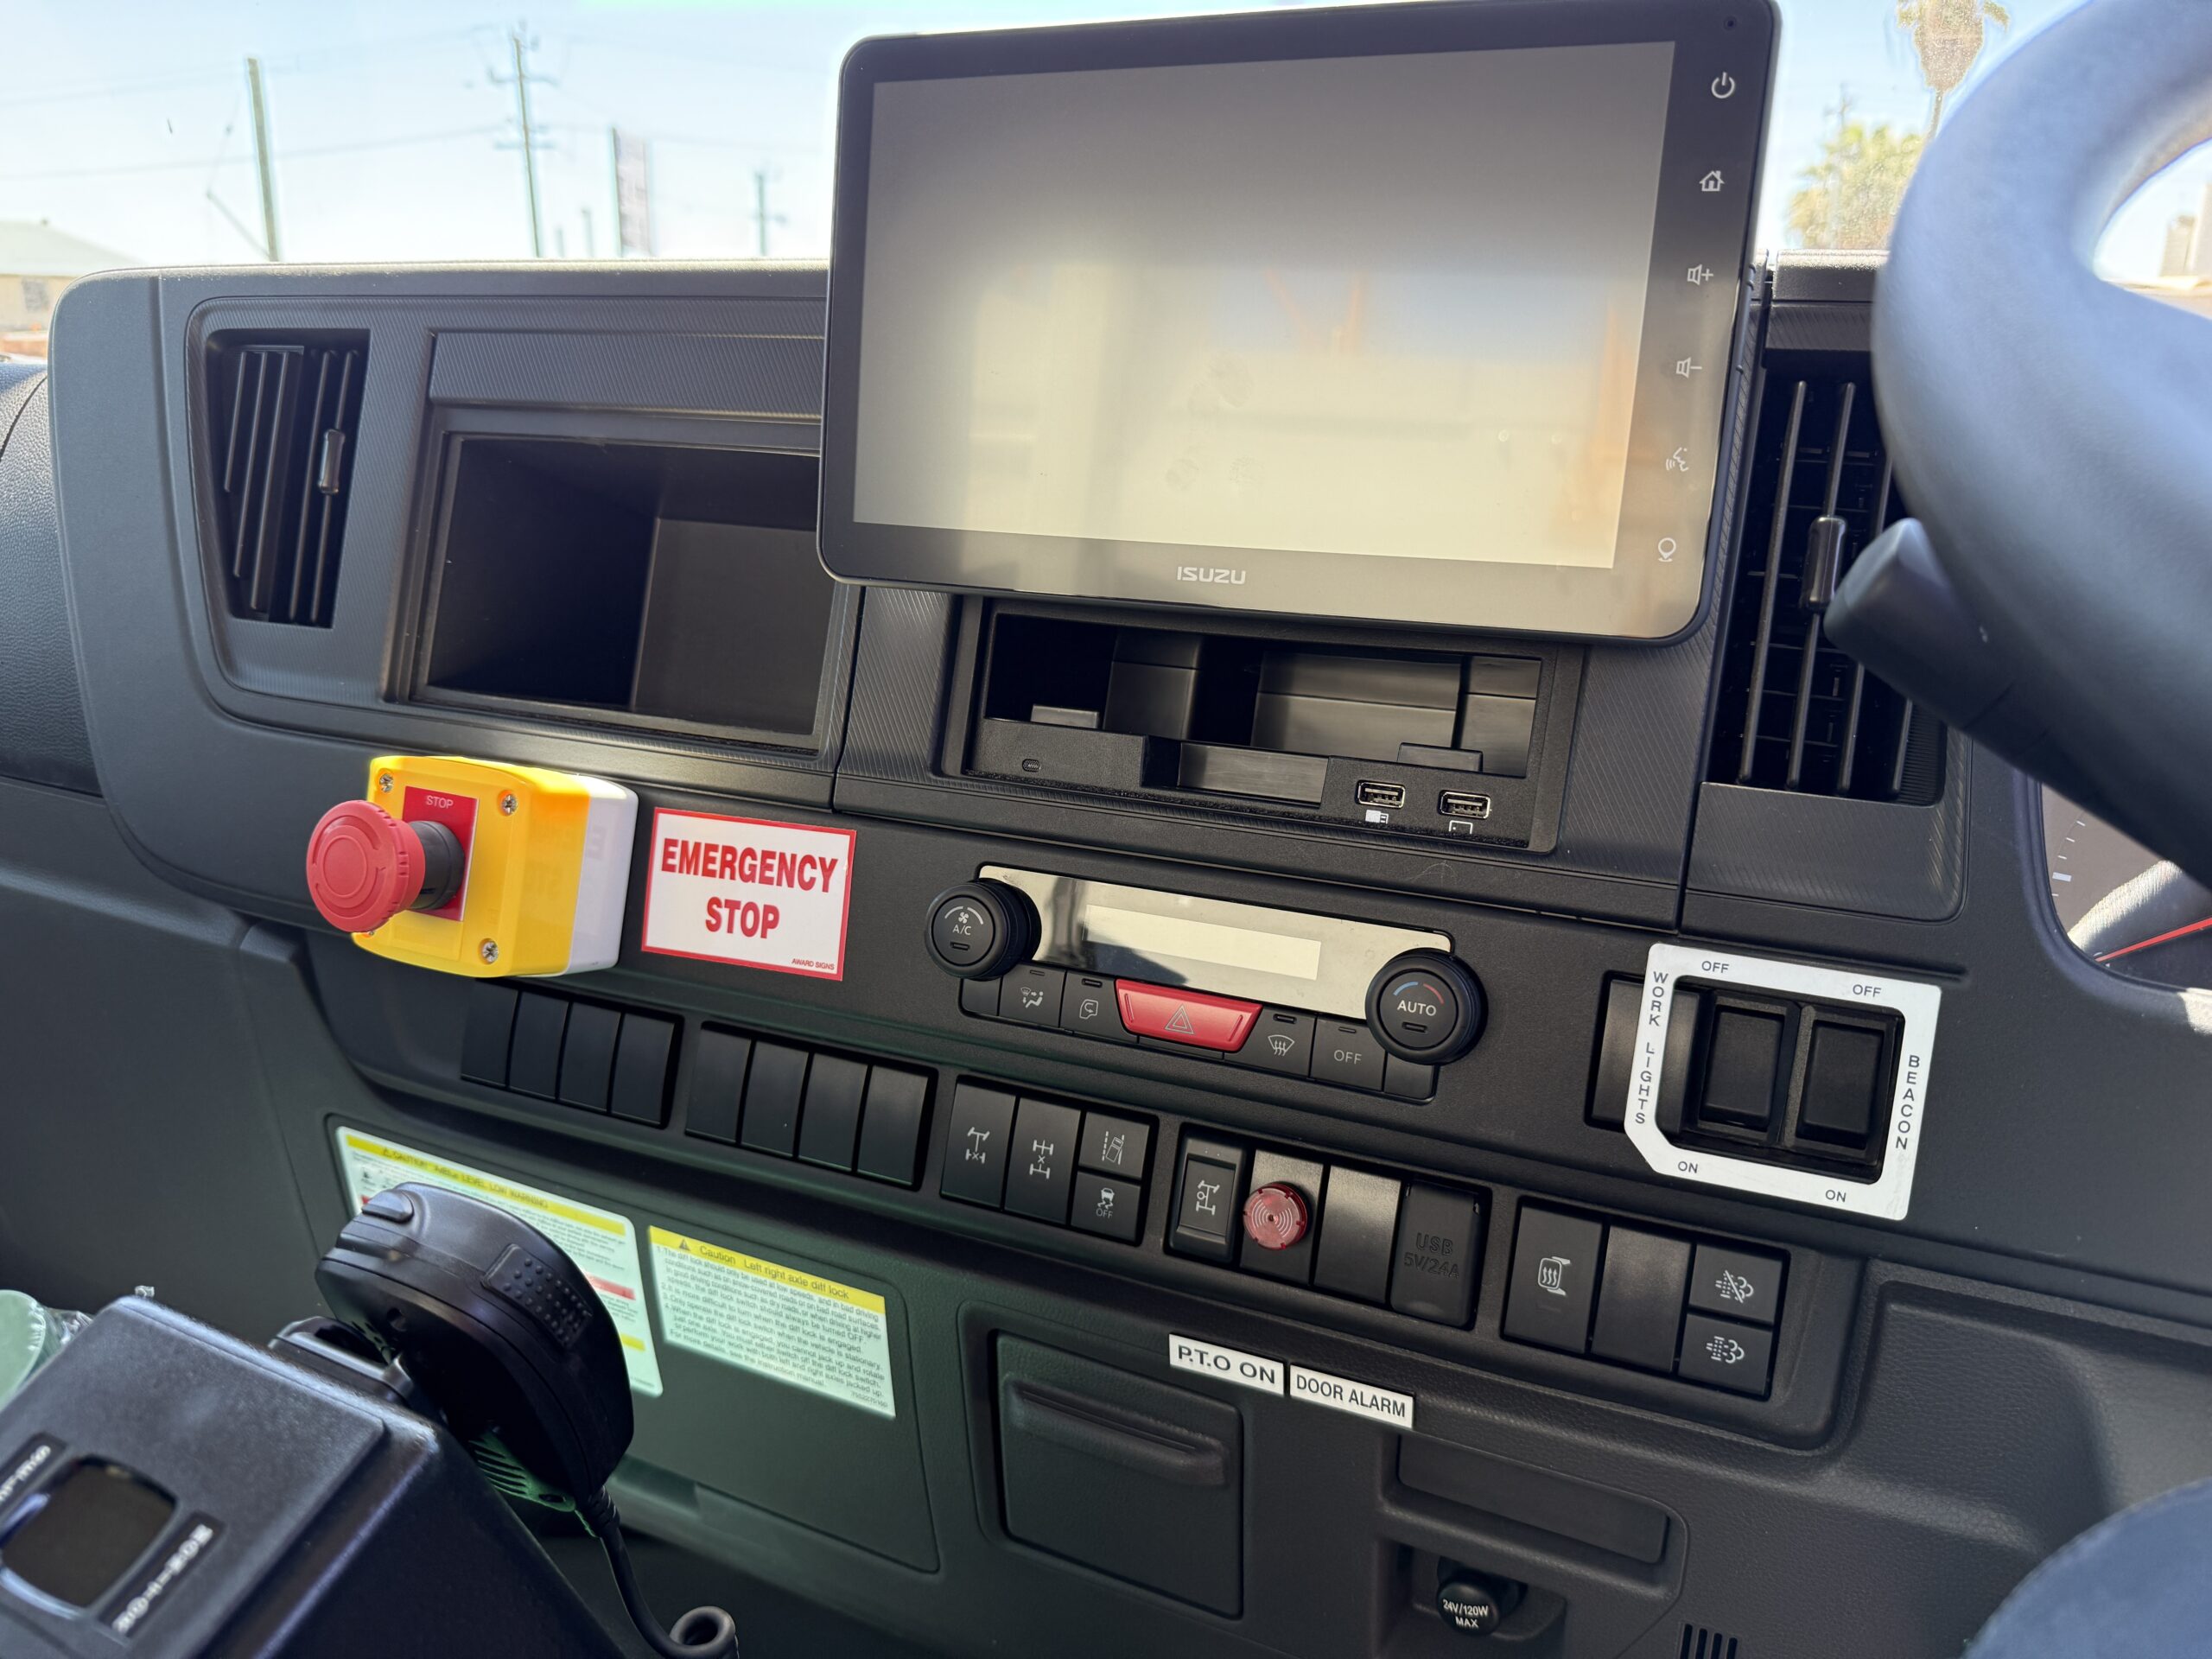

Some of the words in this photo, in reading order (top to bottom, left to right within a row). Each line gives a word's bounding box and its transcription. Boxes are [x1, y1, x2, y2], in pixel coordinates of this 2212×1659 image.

[1177, 566, 1245, 584] ISUZU
[425, 794, 454, 810] STOP
[660, 838, 838, 893] EMERGENCY
[704, 896, 781, 939] STOP
[952, 923, 973, 938] A/C
[791, 958, 815, 969] AWARD
[816, 960, 836, 971] SIGNS
[1701, 960, 1730, 974] OFF
[1649, 971, 1669, 1027] WORK
[1853, 984, 1882, 998] OFF
[1396, 1000, 1438, 1016] AUTO
[1333, 1050, 1362, 1065] OFF
[1634, 1042, 1654, 1124] LIGHTS
[1895, 1055, 1921, 1150] BEACON
[1677, 1160, 1699, 1173] ON
[1825, 1189, 1847, 1203] ON
[1094, 1207, 1114, 1219] OFF
[1415, 1232, 1454, 1255] USB
[699, 1245, 735, 1264] Caution
[743, 1259, 762, 1273] Left
[765, 1267, 785, 1280] right
[787, 1274, 808, 1287] axle
[810, 1279, 826, 1292] diff
[829, 1285, 849, 1300] lock
[1177, 1347, 1231, 1371] P.T.O
[1239, 1363, 1276, 1385] ON
[1296, 1374, 1344, 1401] DOOR
[1348, 1389, 1406, 1419] ALARM
[1442, 1599, 1489, 1617] 24V/120W
[1455, 1616, 1478, 1628] MAX
